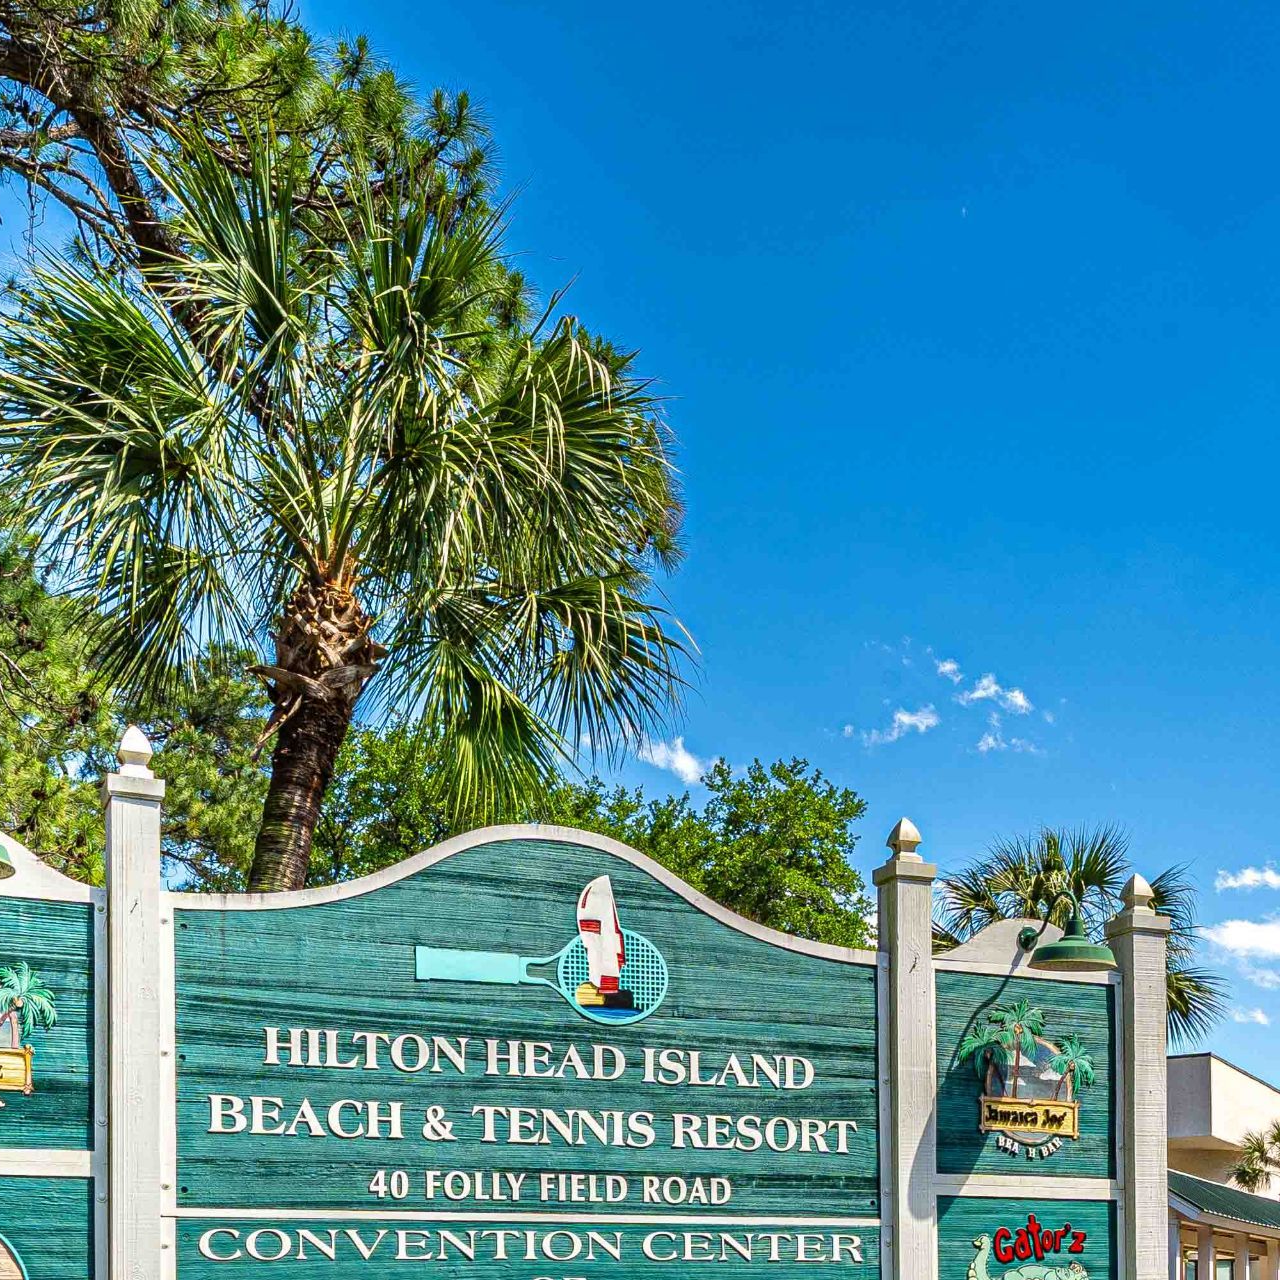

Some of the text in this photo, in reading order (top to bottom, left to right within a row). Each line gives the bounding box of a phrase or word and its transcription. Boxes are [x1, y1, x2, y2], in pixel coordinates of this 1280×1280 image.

[263, 1027, 815, 1090] HILTON HEAD ISLAND
[207, 1095, 858, 1154] BEACH & TENNIS RESORT
[1041, 1137, 1063, 1157] BAR
[369, 1170, 732, 1205] 40 FOLLY FIELD ROAD
[198, 1228, 864, 1263] CONVENTION CENTER
